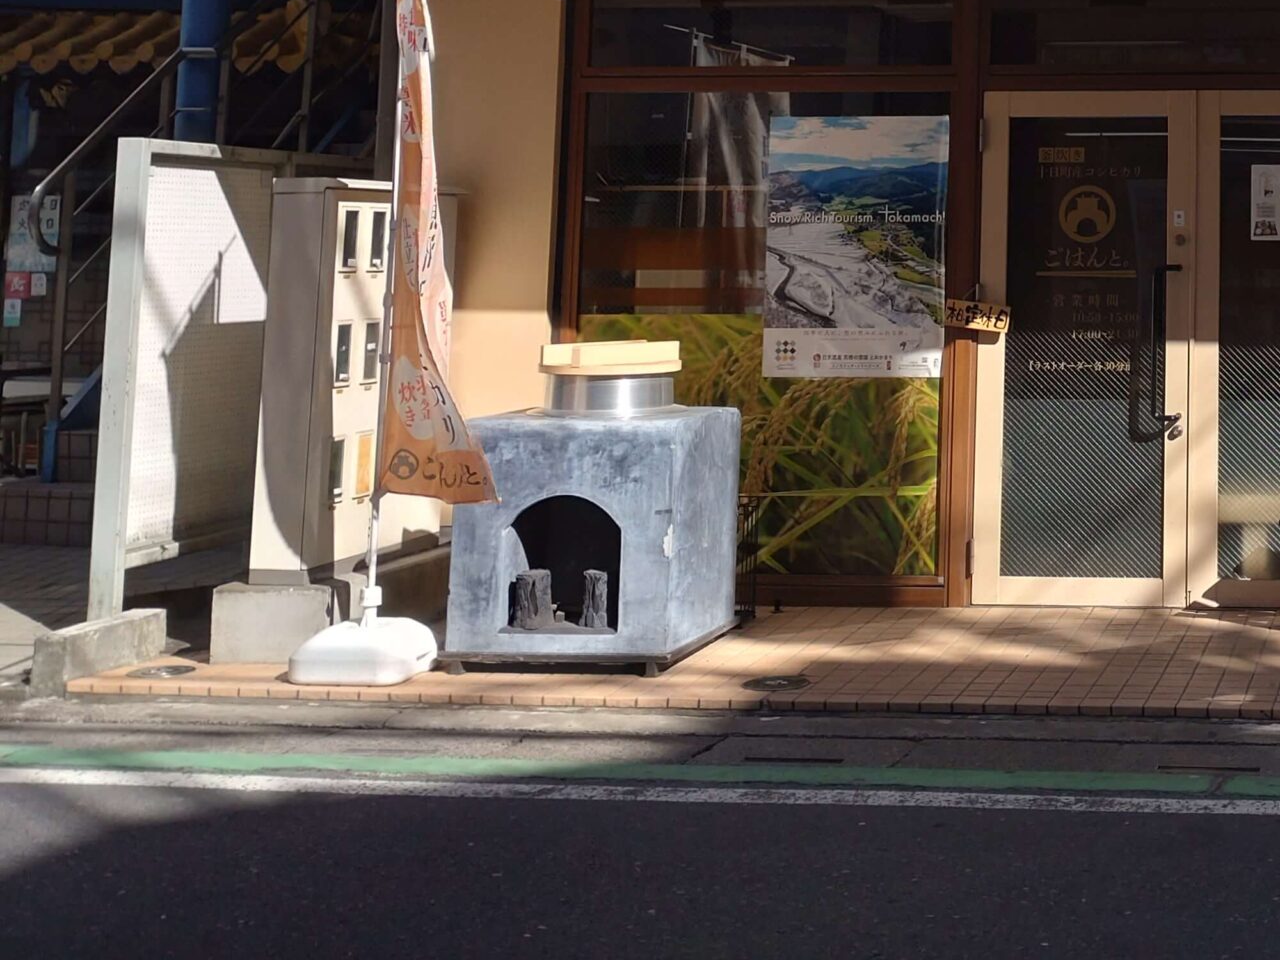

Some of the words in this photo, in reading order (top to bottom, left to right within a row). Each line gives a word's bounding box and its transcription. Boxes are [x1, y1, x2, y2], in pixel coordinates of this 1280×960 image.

[769, 211, 801, 224] Snow
[804, 211, 831, 223] Rich
[830, 211, 874, 224] Tourism
[1044, 247, 1129, 268] ごはんと。
[946, 301, 1009, 330] 本日定休日
